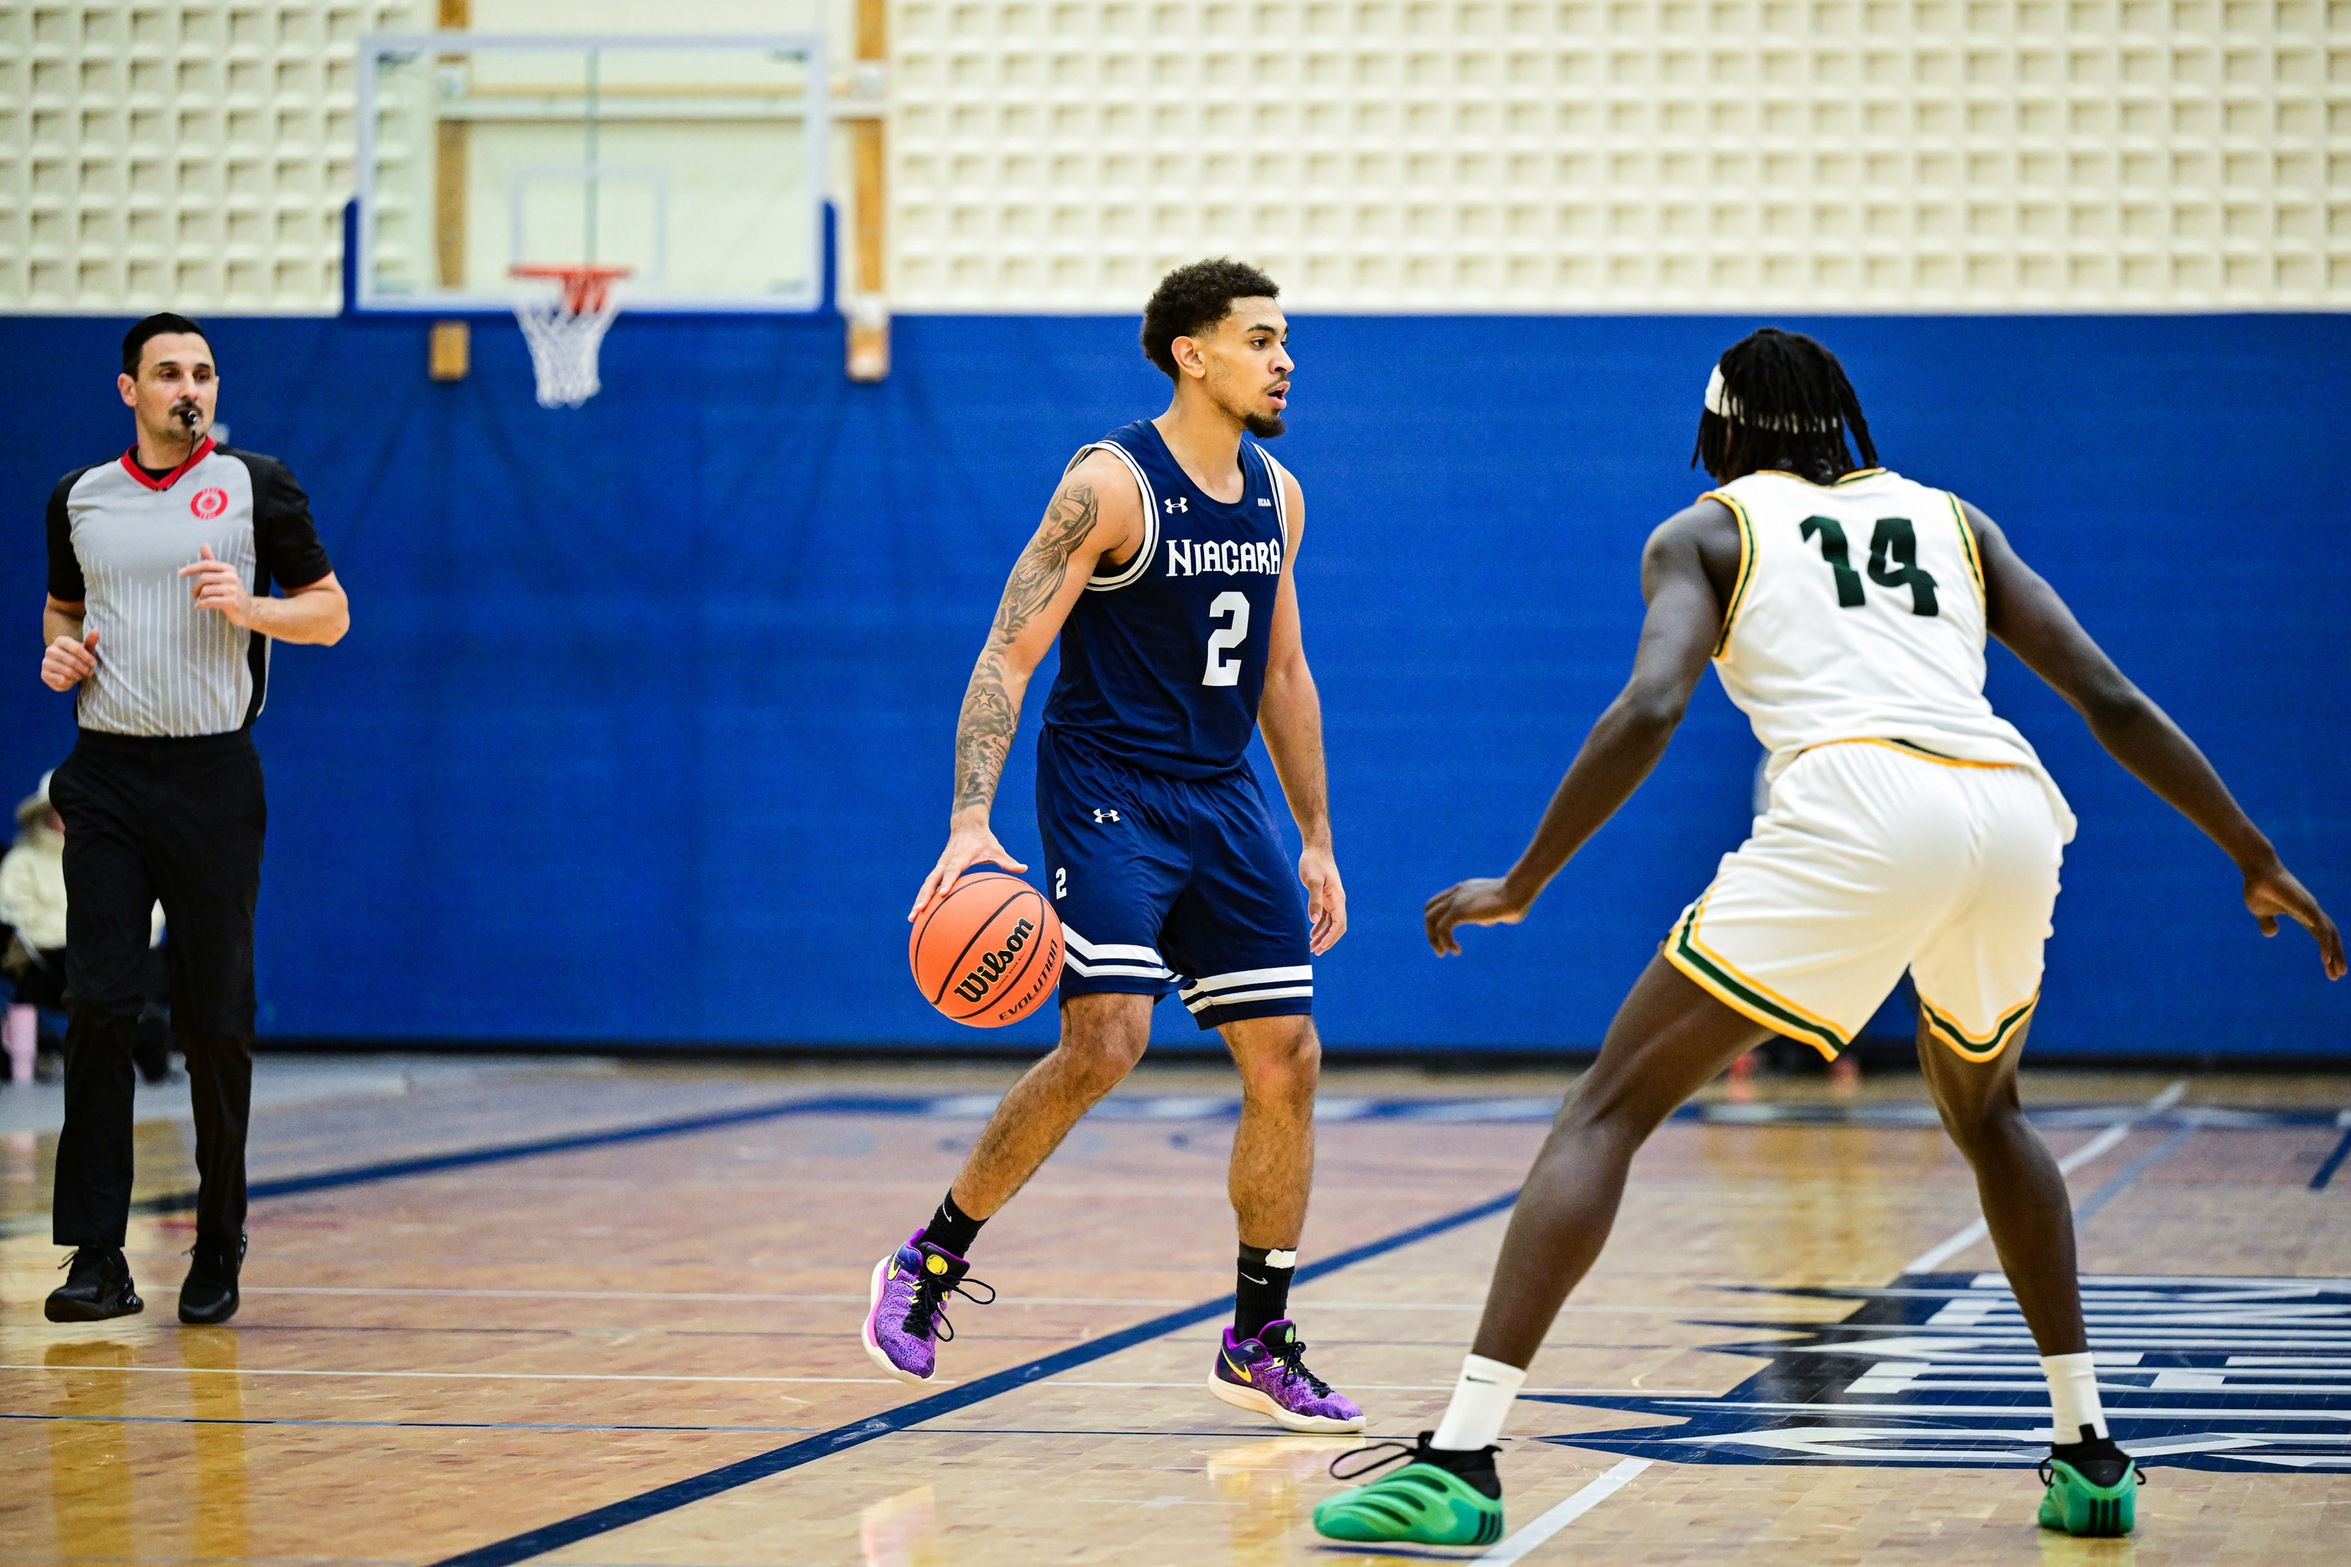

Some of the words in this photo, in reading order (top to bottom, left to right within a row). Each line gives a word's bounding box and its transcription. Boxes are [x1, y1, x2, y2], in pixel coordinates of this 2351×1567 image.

[1165, 537, 1281, 577] NIAGARA
[1799, 515, 1939, 617] 14
[1201, 591, 1250, 687] 2
[1055, 867, 1067, 900] 2
[952, 917, 1035, 1003] Wilson
[998, 938, 1058, 1021] EVOLUTION
